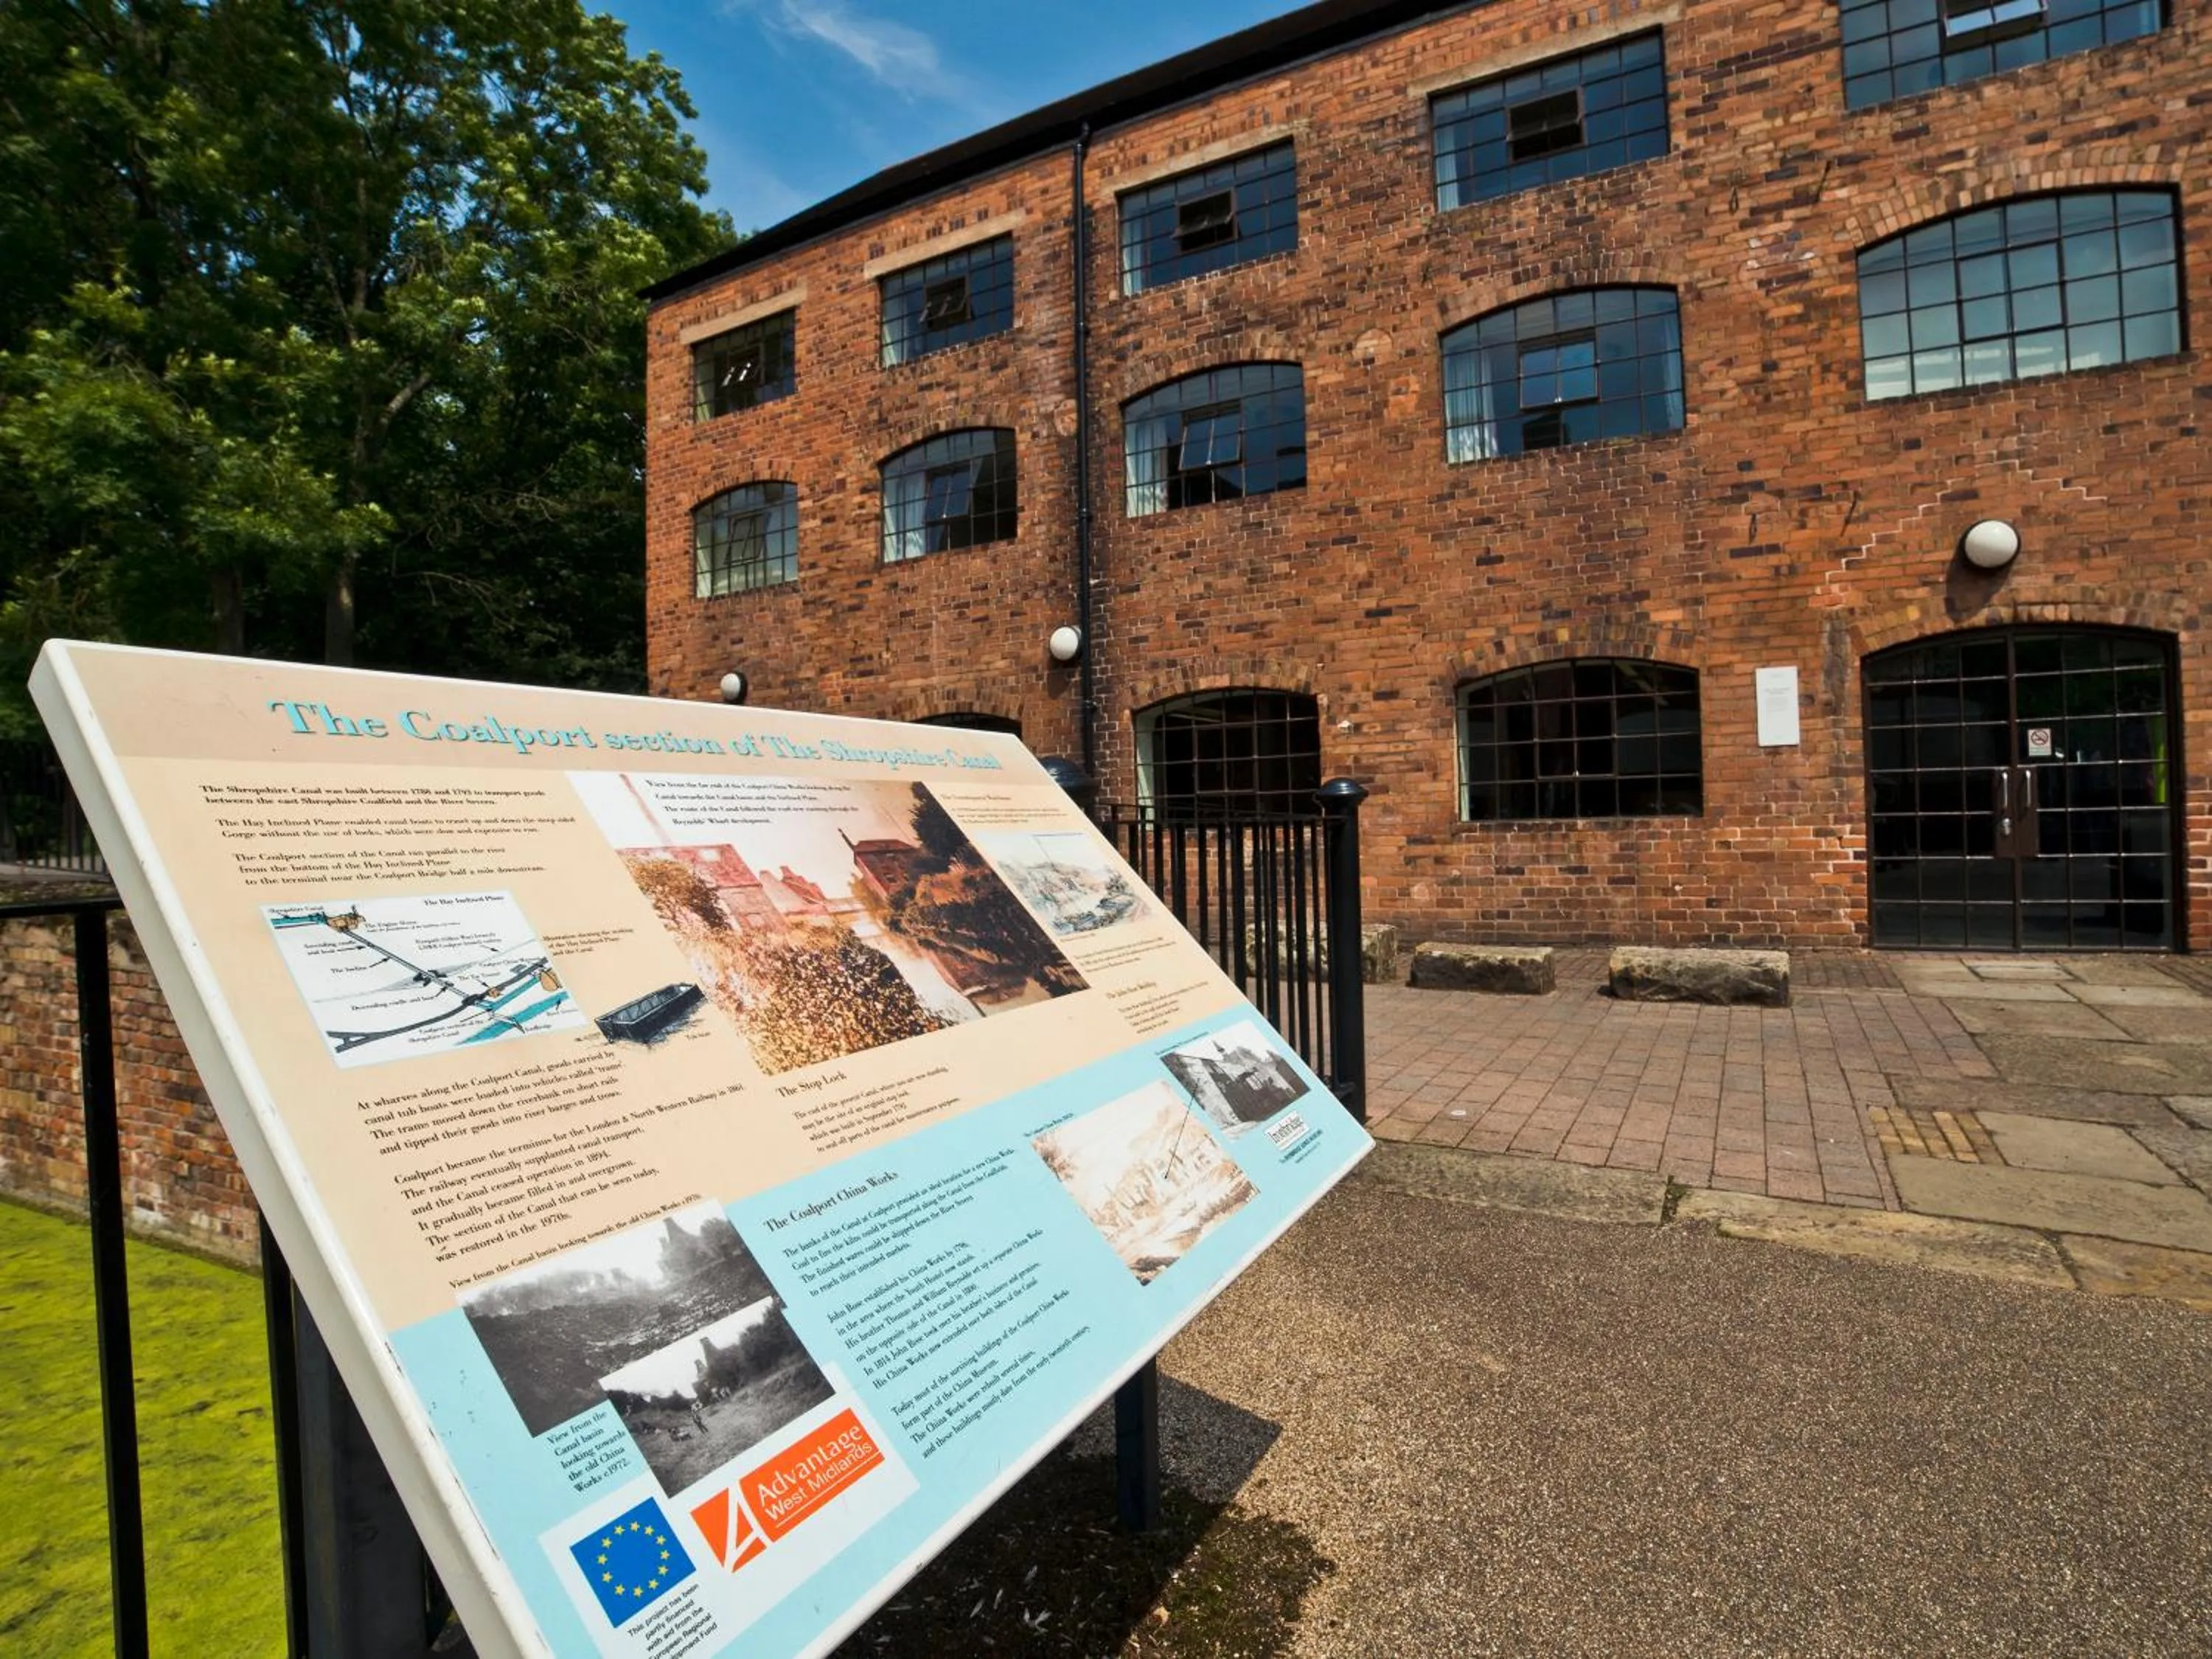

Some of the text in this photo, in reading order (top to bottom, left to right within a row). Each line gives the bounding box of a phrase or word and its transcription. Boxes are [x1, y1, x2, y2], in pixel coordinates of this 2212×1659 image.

[267, 700, 1003, 771] The Coalport section of The Shropshire Canal
[358, 1101, 370, 1110] At
[372, 1093, 417, 1106] wharves
[420, 1086, 451, 1097] along
[451, 1082, 469, 1091] the
[470, 1072, 513, 1085] Coalport
[546, 1059, 572, 1072] goods
[573, 1051, 603, 1064] carried
[602, 1051, 614, 1059] by
[364, 1110, 394, 1126] canal
[397, 1107, 417, 1118] tub
[417, 1102, 448, 1113] boats
[449, 1096, 473, 1105] were
[475, 1085, 509, 1101] loaded
[509, 1084, 530, 1092] into
[532, 1074, 567, 1087] vehicles
[568, 1067, 594, 1079] called
[775, 1071, 846, 1097] The Stop Lock
[369, 1129, 395, 1139] The
[397, 1121, 429, 1134] trams
[431, 1110, 466, 1125] moved
[468, 1106, 495, 1117] down
[496, 1101, 513, 1110] the
[515, 1089, 560, 1106] riverbank
[576, 1081, 599, 1091] short
[379, 1141, 401, 1155] and
[403, 1132, 439, 1150] tipped
[441, 1127, 467, 1138] their
[470, 1119, 500, 1135] goods
[501, 1115, 521, 1124] into
[524, 1108, 545, 1119] river
[546, 1102, 577, 1113] barges
[579, 1094, 596, 1105] and
[394, 1165, 444, 1184] Coalport
[445, 1155, 487, 1170] became
[488, 1150, 506, 1159] the
[508, 1138, 552, 1154] terminus
[552, 1133, 567, 1141] for
[568, 1128, 585, 1137] the
[585, 1119, 620, 1133] London
[629, 1108, 655, 1119] North
[655, 1101, 687, 1112] Western
[687, 1093, 717, 1104] Railway
[400, 1188, 425, 1199] The
[428, 1177, 467, 1192] railway
[470, 1160, 521, 1180] eventually
[524, 1144, 575, 1165] supplanted
[577, 1136, 602, 1150] canal
[411, 1200, 433, 1215] and
[434, 1197, 454, 1208] the
[456, 1185, 489, 1200] Canal
[490, 1175, 524, 1192] ceased
[525, 1163, 572, 1182] operation
[572, 1158, 584, 1166] in
[417, 1220, 429, 1231] It
[432, 1205, 482, 1230] gradually
[484, 1194, 525, 1210] became
[526, 1182, 554, 1197] filled
[554, 1180, 566, 1189] in
[567, 1172, 586, 1185] and
[424, 1234, 450, 1246] The
[453, 1220, 492, 1237] section
[494, 1213, 505, 1224] of
[507, 1210, 525, 1220] the
[526, 1197, 557, 1213] Canal
[557, 1192, 578, 1203] that
[580, 1187, 597, 1197] can
[597, 1182, 610, 1191] be
[612, 1176, 631, 1186] seen
[762, 1171, 898, 1232] The Coalport China Works
[435, 1248, 457, 1262] was
[459, 1232, 504, 1255] restored
[505, 1229, 518, 1239] in
[519, 1223, 537, 1234] the
[546, 1411, 606, 1444] View from the
[554, 1428, 604, 1456] Canal basin
[560, 1430, 625, 1469] looking towards
[568, 1447, 625, 1481] the old China
[573, 1475, 602, 1492] Works
[757, 1425, 863, 1507] Advantage
[765, 1443, 872, 1520] West Midlands
[627, 1583, 699, 1636] This project has been
[645, 1599, 695, 1640] partly financed
[647, 1607, 704, 1652] with aid from the
[682, 1613, 713, 1638] Regional
[700, 1622, 717, 1639] Fund
